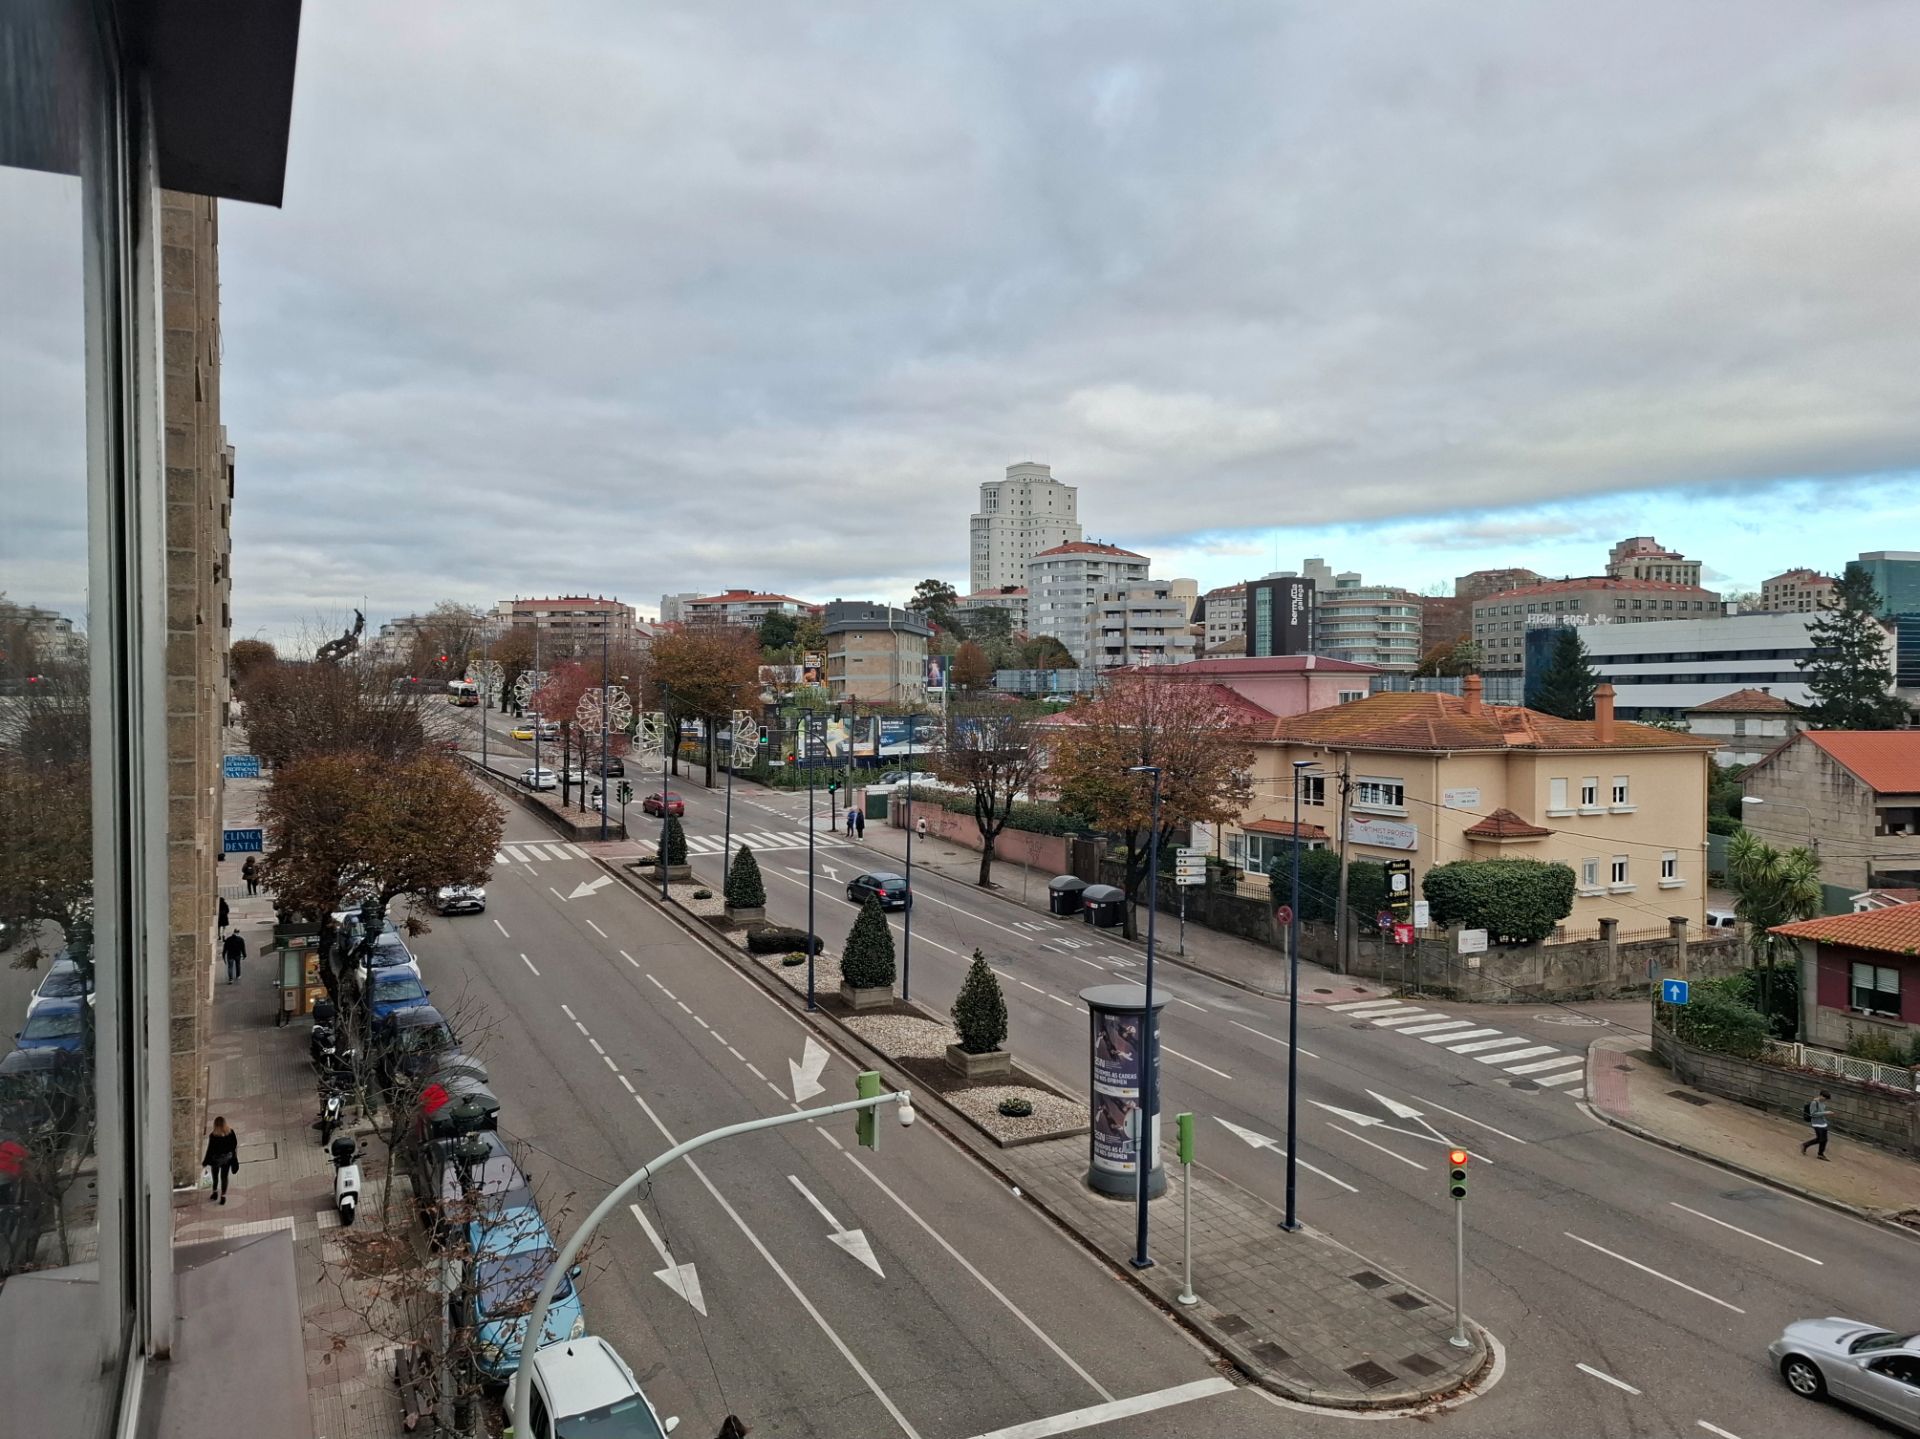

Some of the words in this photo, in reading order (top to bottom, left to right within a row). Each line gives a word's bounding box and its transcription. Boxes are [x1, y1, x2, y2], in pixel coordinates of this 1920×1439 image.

[224, 831, 262, 840] CLINICA
[1387, 828, 1413, 838] PROJECT
[225, 842, 260, 851] DENTAL
